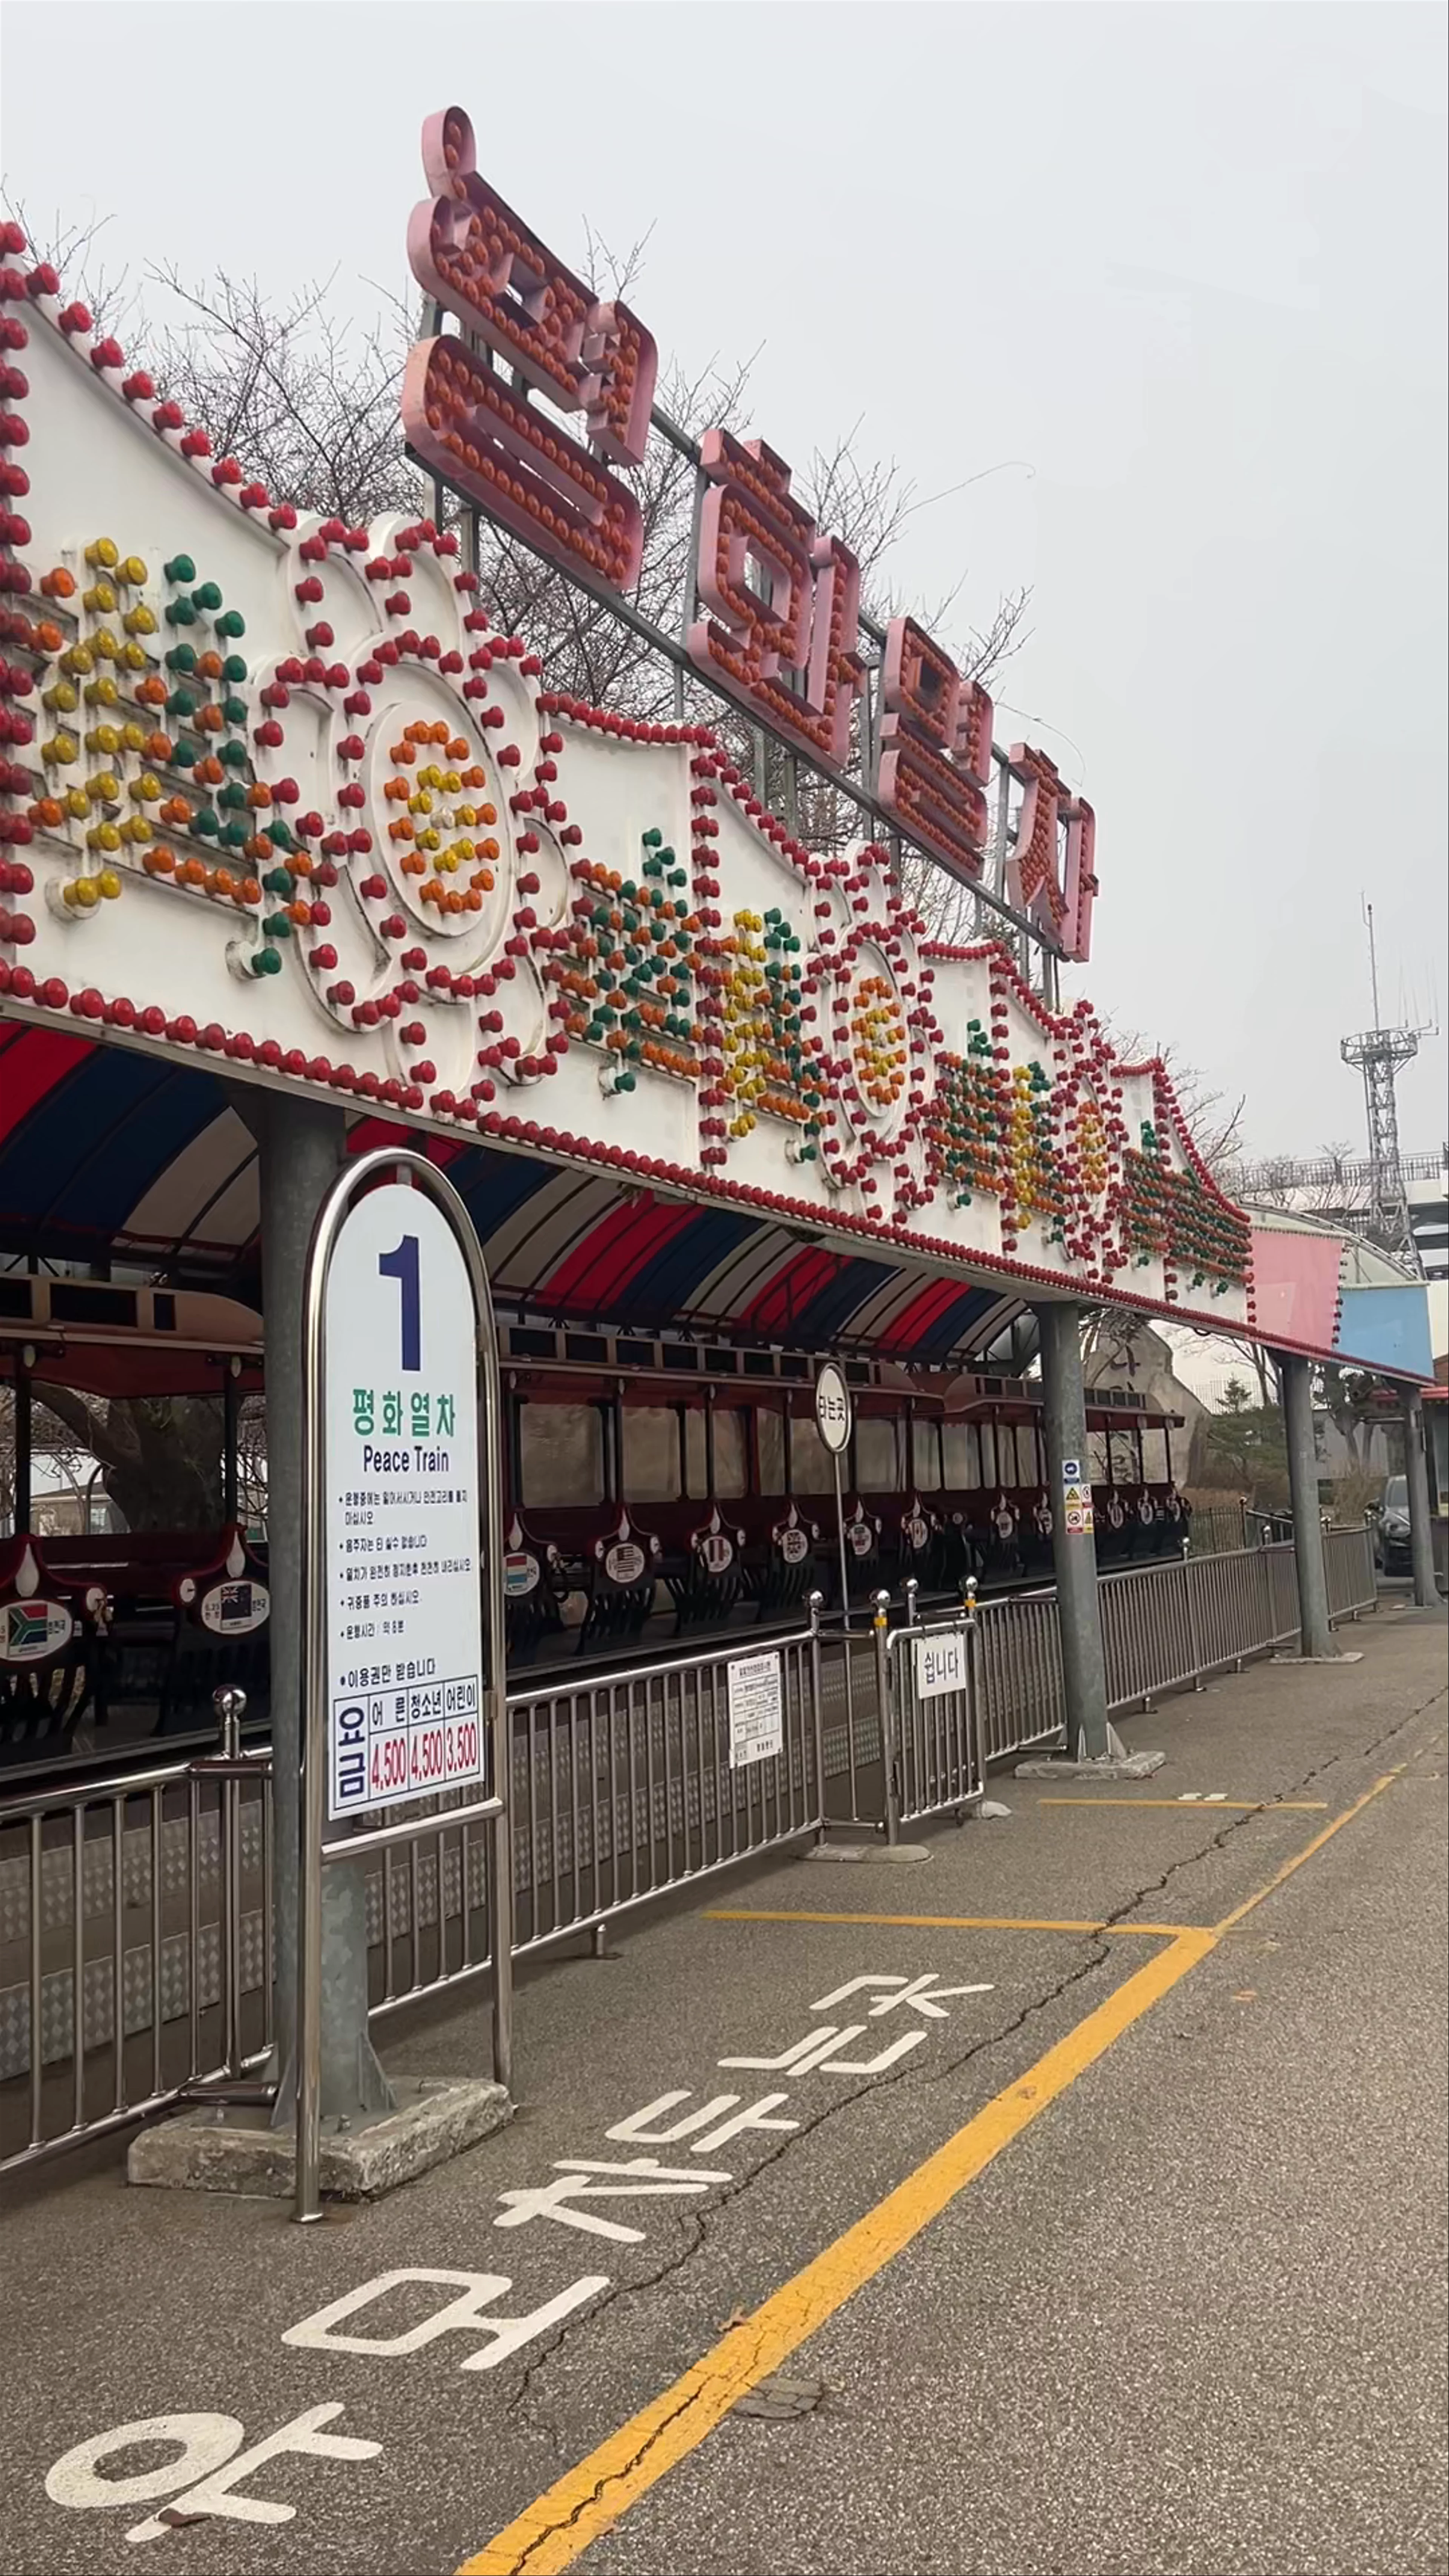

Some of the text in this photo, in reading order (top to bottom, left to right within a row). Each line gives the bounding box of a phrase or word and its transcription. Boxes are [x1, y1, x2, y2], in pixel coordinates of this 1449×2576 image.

[401, 106, 1099, 963] 평화열차
[378, 1235, 421, 1371] 1
[353, 1389, 456, 1437] 평화열차
[820, 1396, 844, 1421] 타는곳
[363, 1445, 449, 1472] Peace Train
[346, 1512, 373, 1525] 마십시오
[346, 1538, 374, 1552] 음주자는
[347, 1566, 367, 1581] 열차가
[348, 1595, 370, 1610] 귀중품
[348, 1658, 435, 1688] 이용권만 받습니다
[924, 1647, 958, 1684] 쉽니다
[411, 1692, 440, 1719] 청소년
[447, 1684, 475, 1711] 어린이
[338, 1707, 365, 1798] 요금
